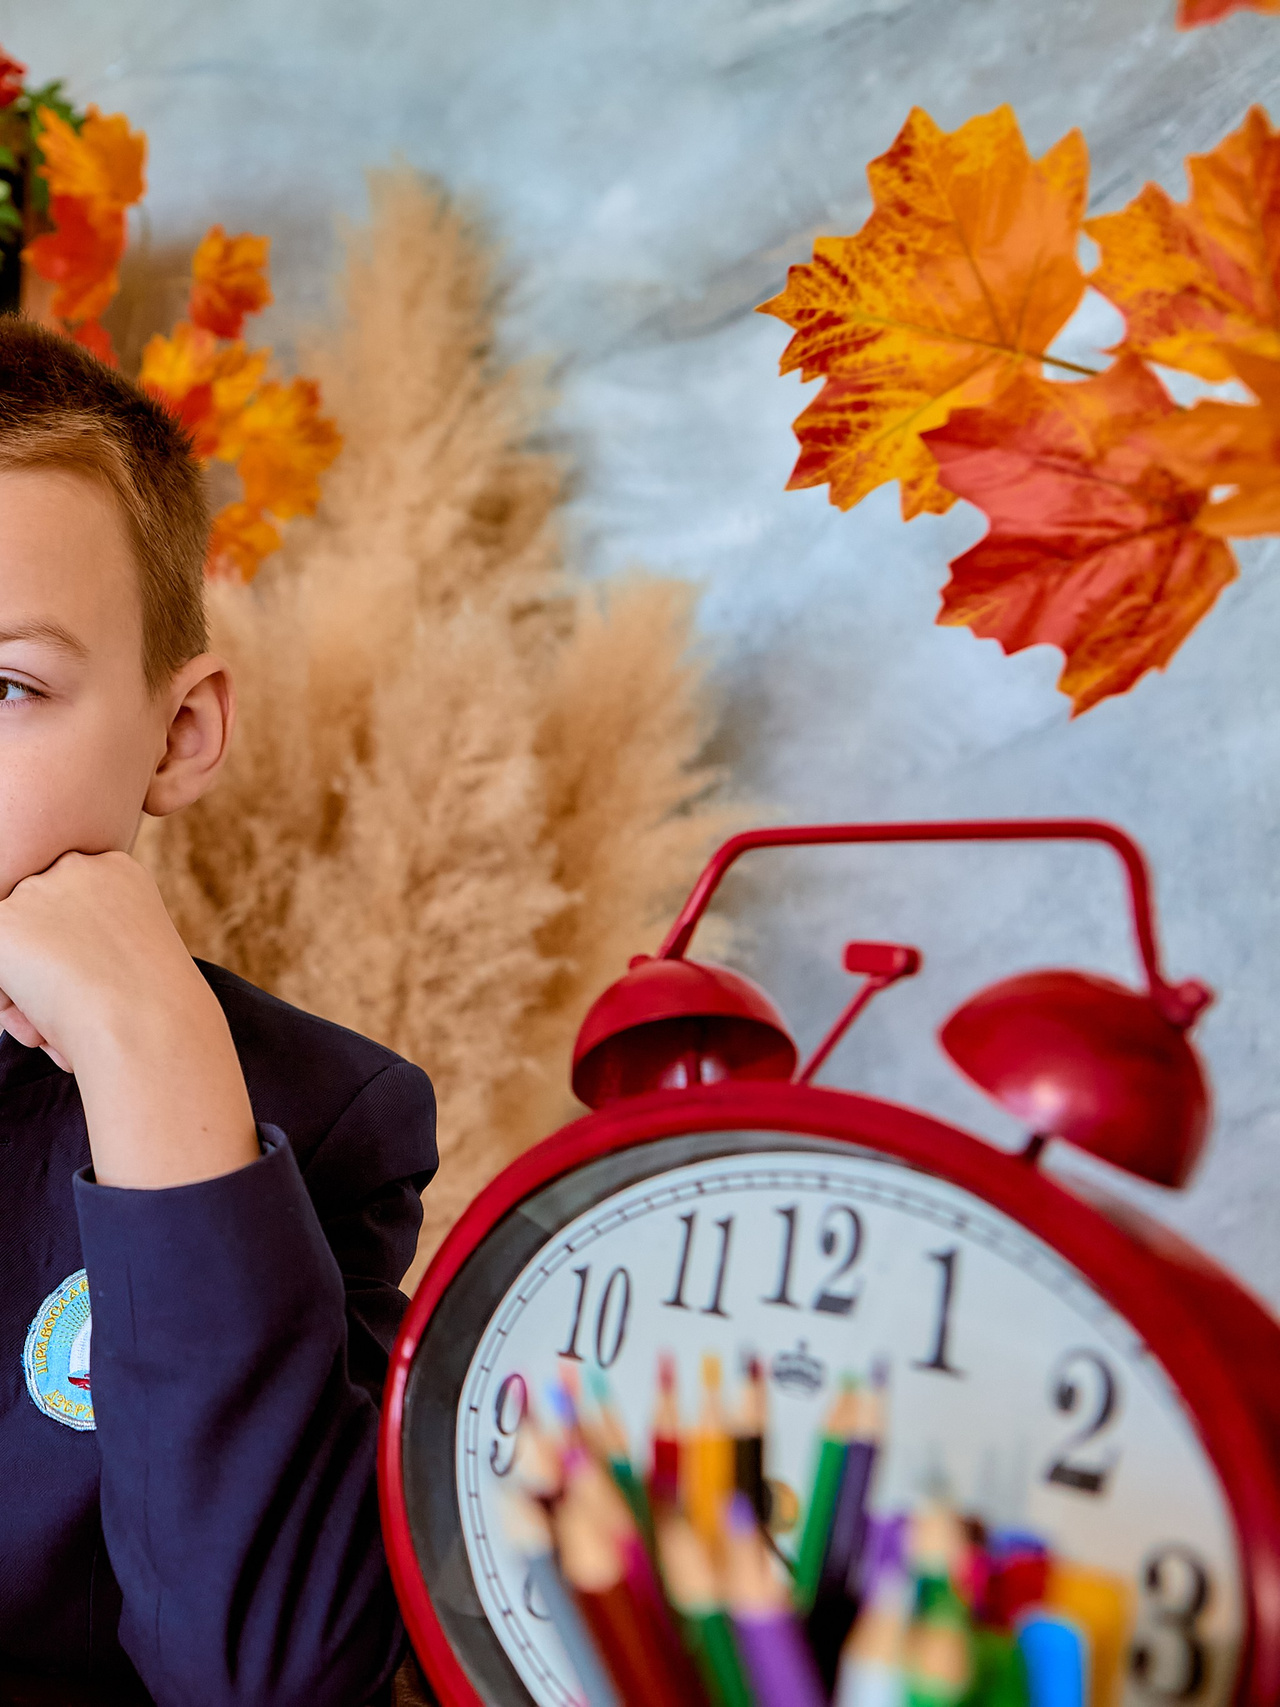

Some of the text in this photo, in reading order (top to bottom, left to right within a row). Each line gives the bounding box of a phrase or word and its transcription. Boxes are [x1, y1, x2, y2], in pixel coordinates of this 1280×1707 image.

[662, 1212, 733, 1318] 11
[760, 1204, 866, 1316] 12
[915, 1248, 964, 1377] 1
[555, 1265, 632, 1368] 10
[488, 1373, 529, 1477] 9
[1048, 1348, 1118, 1494] 2
[1128, 1545, 1210, 1704] 3
